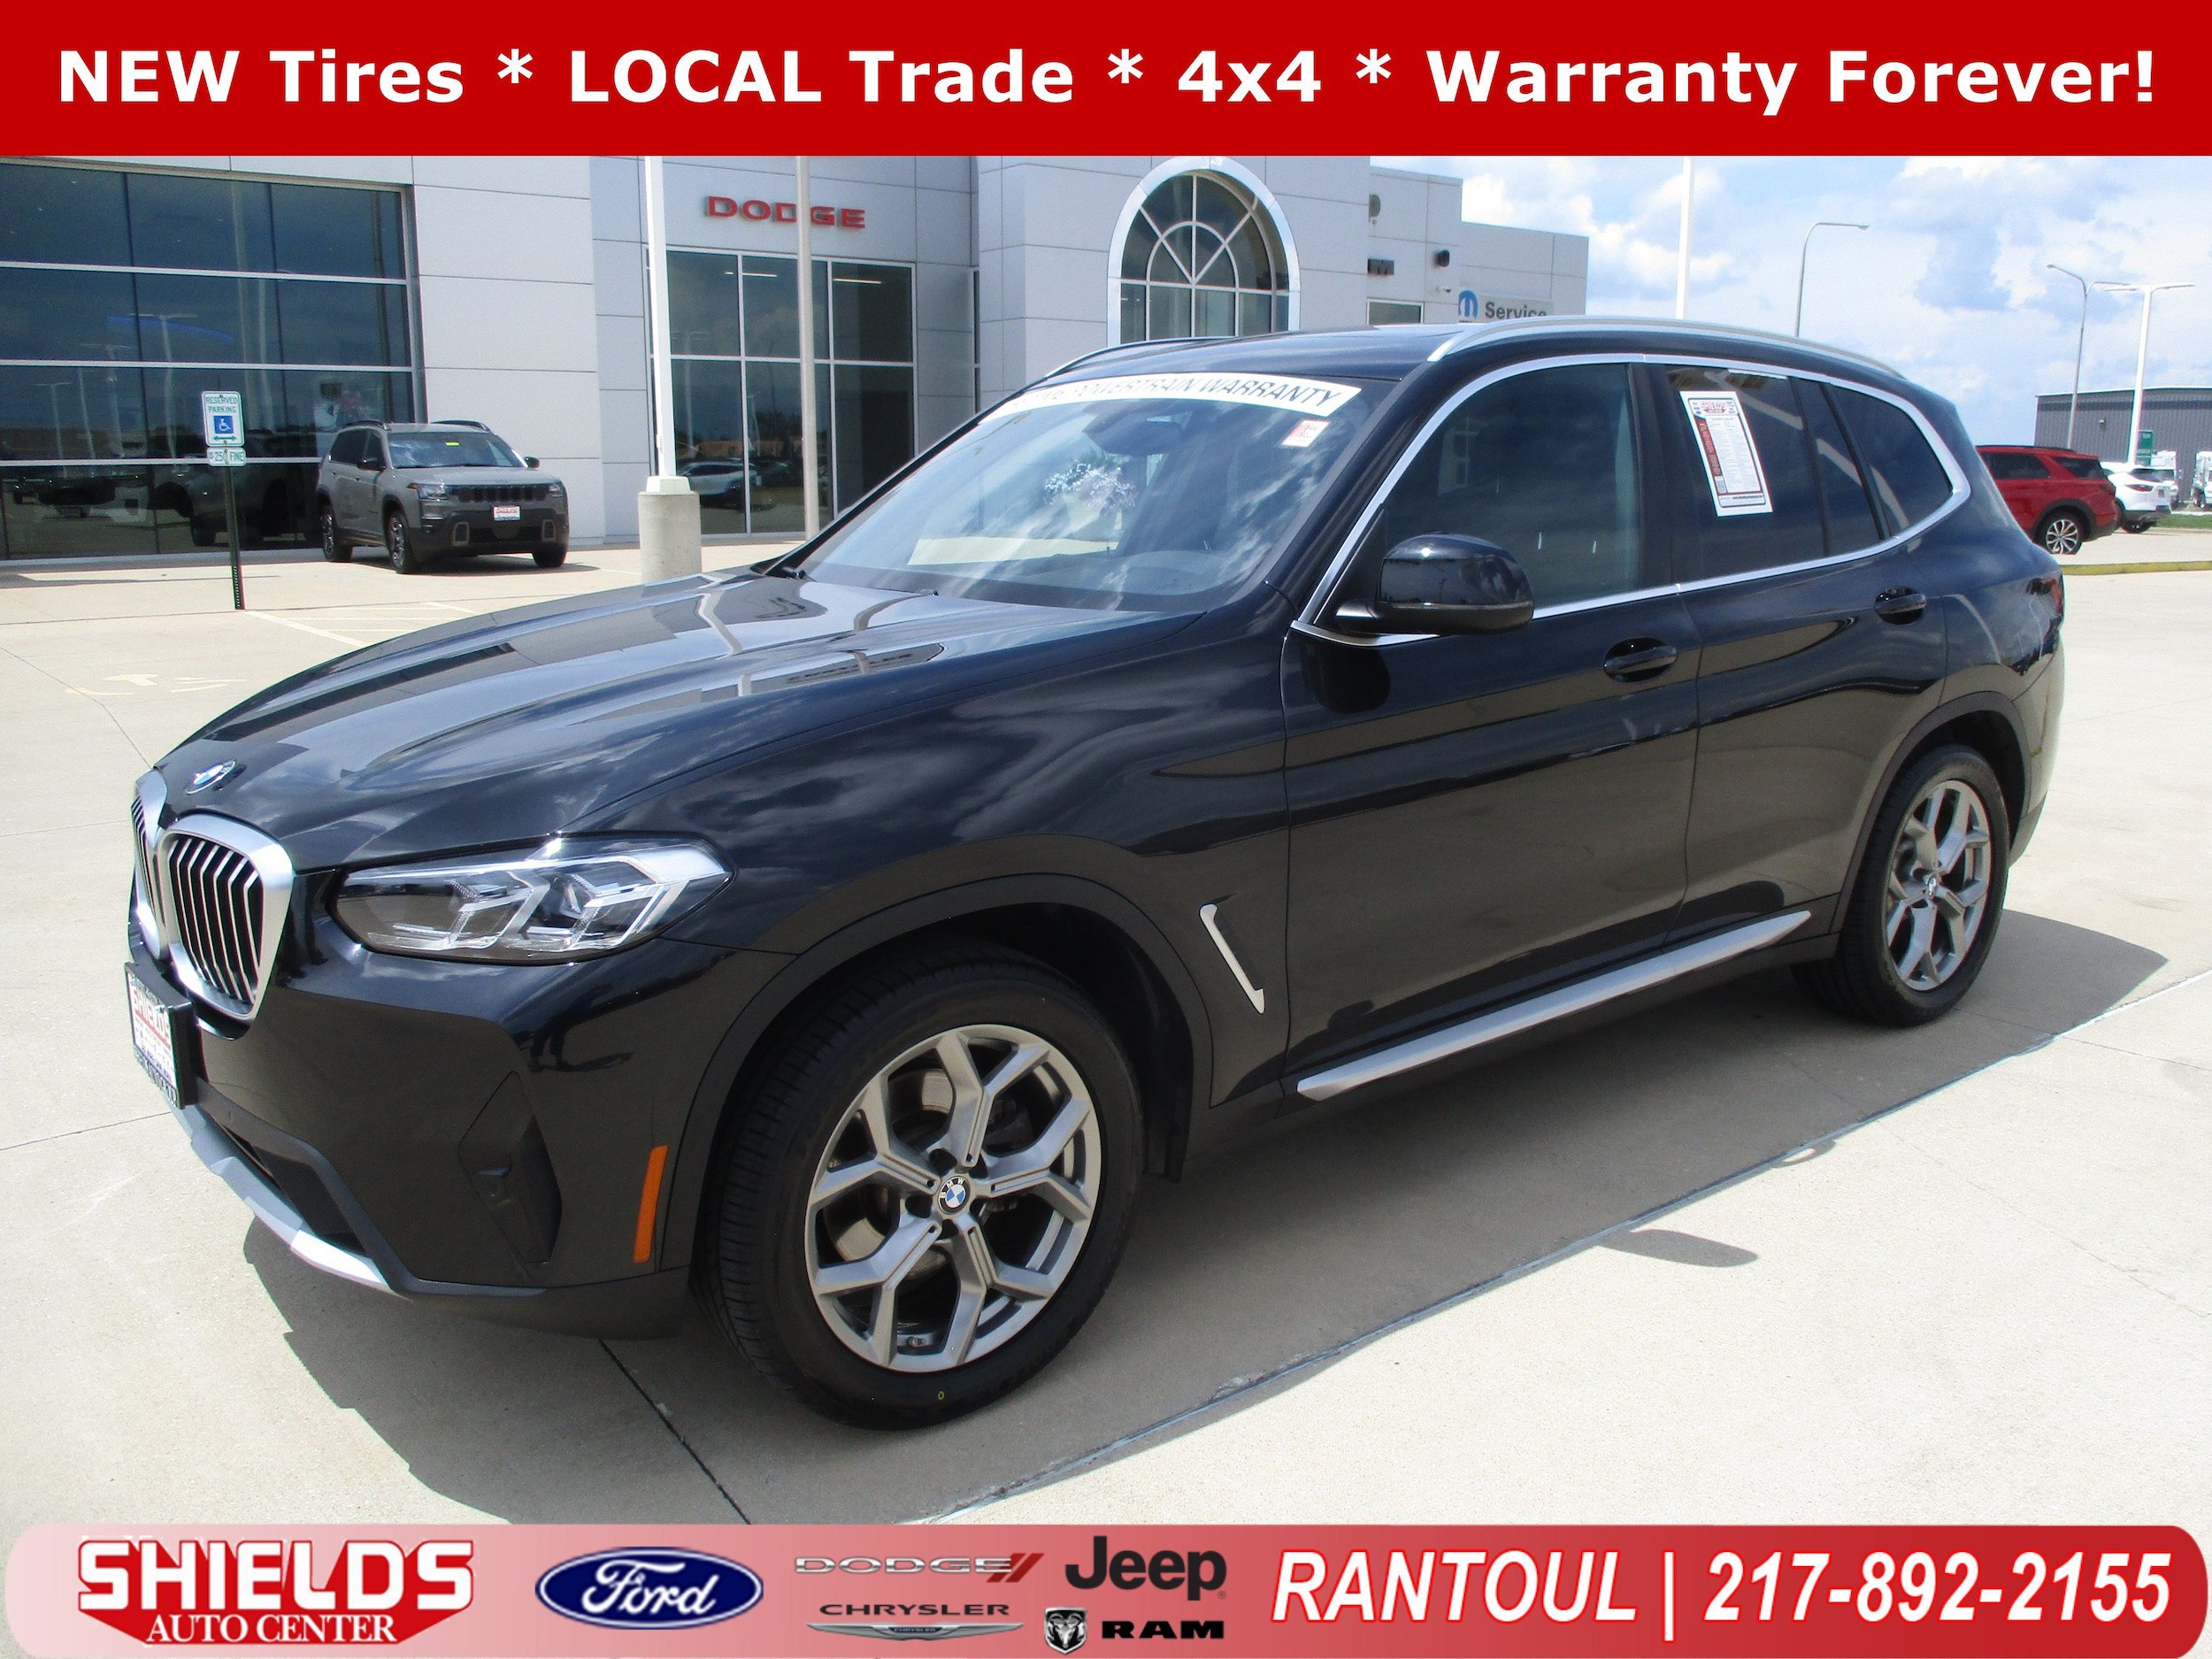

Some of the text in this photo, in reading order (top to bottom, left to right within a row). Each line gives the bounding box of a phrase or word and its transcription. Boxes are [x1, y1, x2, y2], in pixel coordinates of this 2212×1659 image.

[708, 196, 865, 228] DODGE
[1198, 378, 1341, 407] WARRANTY
[940, 1178, 964, 1199] BMW
